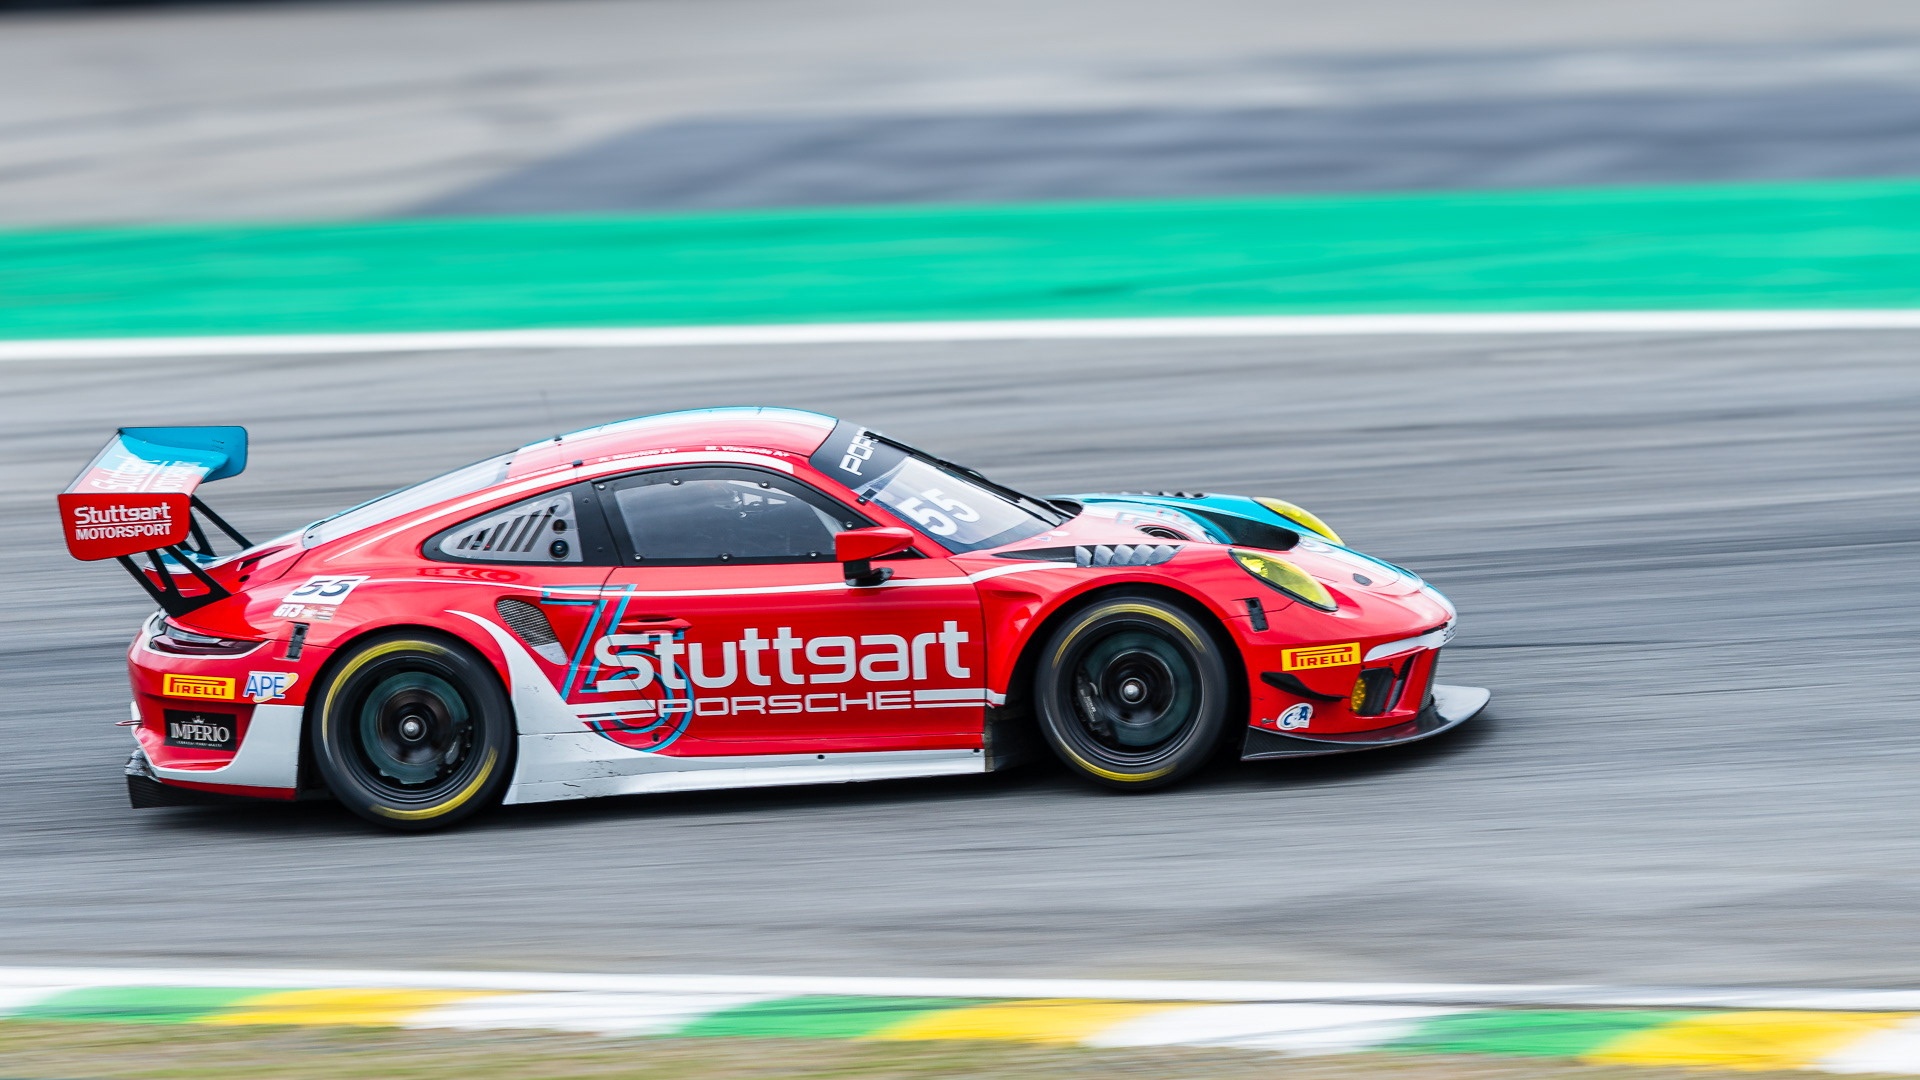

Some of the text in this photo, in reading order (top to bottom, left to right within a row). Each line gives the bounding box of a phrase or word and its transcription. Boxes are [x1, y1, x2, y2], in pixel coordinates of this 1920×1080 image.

[73, 502, 171, 525] Stuttgart
[896, 488, 981, 536] 55
[75, 522, 172, 541] MOTORSPORT
[291, 578, 360, 597] 55
[272, 604, 306, 618] GT3
[594, 620, 971, 693] Stuttgart
[1290, 646, 1354, 668] PIRELLI
[169, 676, 227, 697] PIRELLI
[244, 675, 286, 698] APE
[657, 690, 912, 718] PORSCHE
